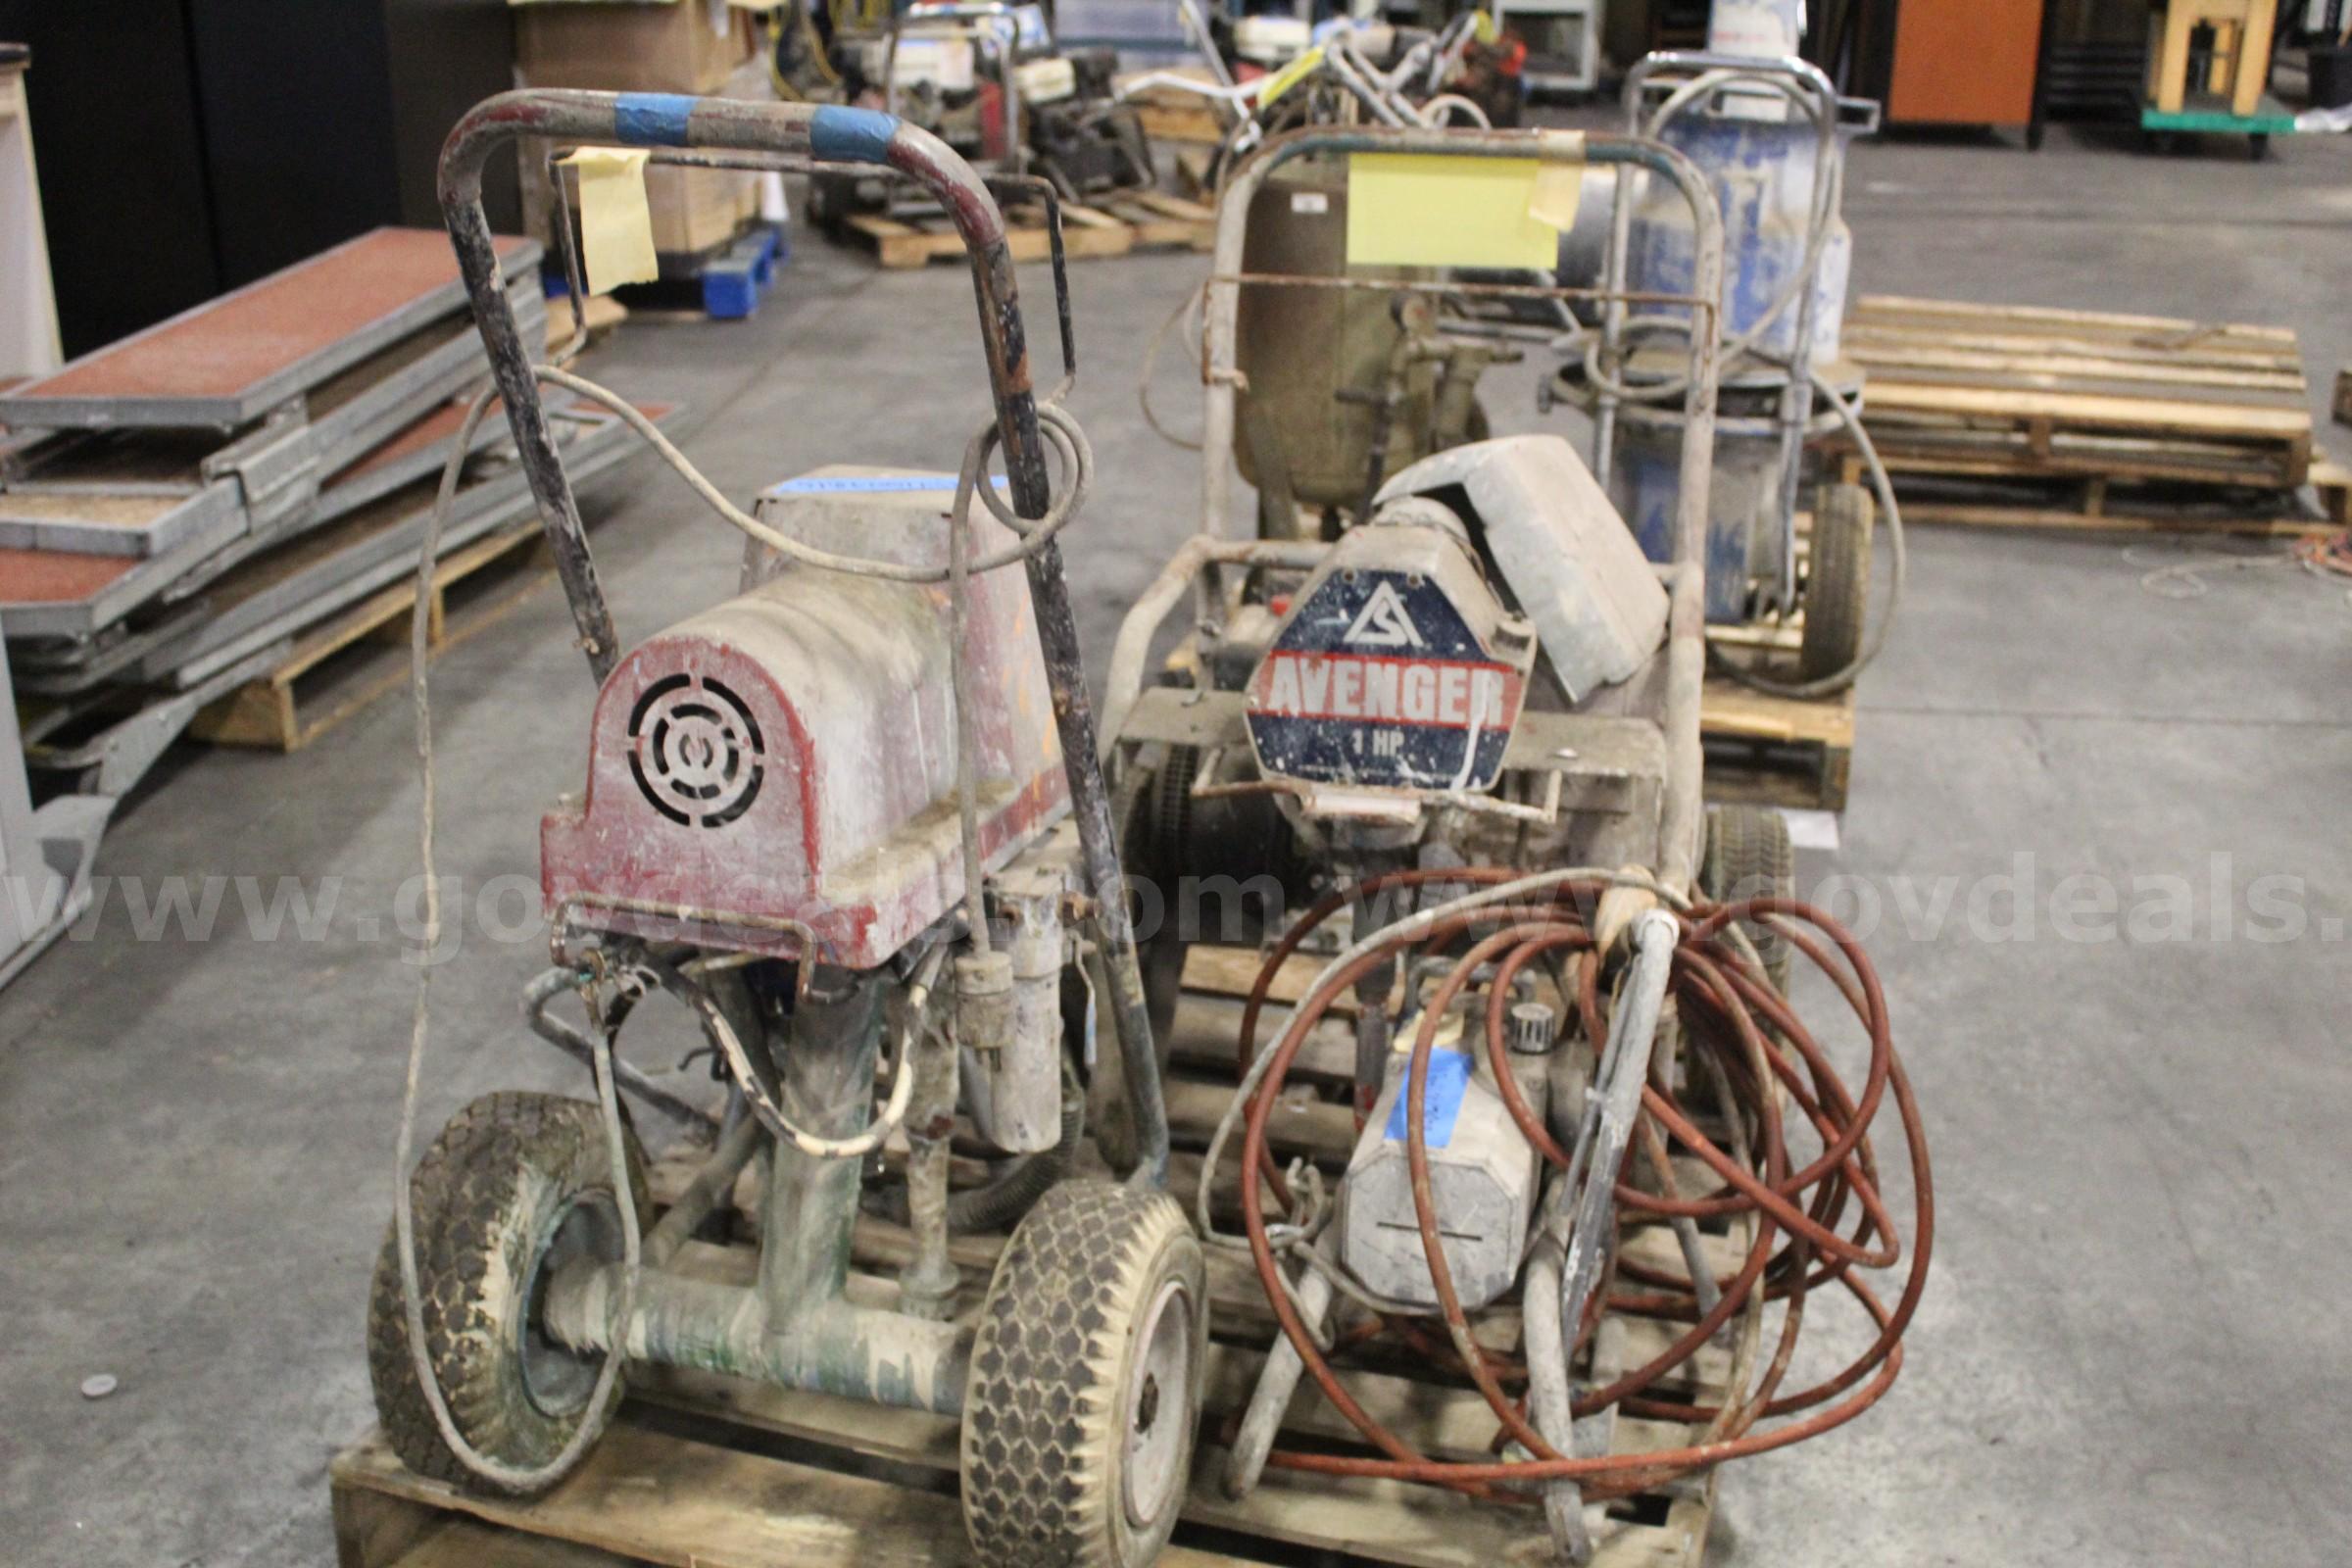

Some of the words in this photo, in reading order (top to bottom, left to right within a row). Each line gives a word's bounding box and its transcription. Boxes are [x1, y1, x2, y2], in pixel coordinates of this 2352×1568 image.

[1269, 656, 1504, 725] AVENGER
[1351, 729, 1363, 754] 1
[1372, 729, 1405, 757] HP
